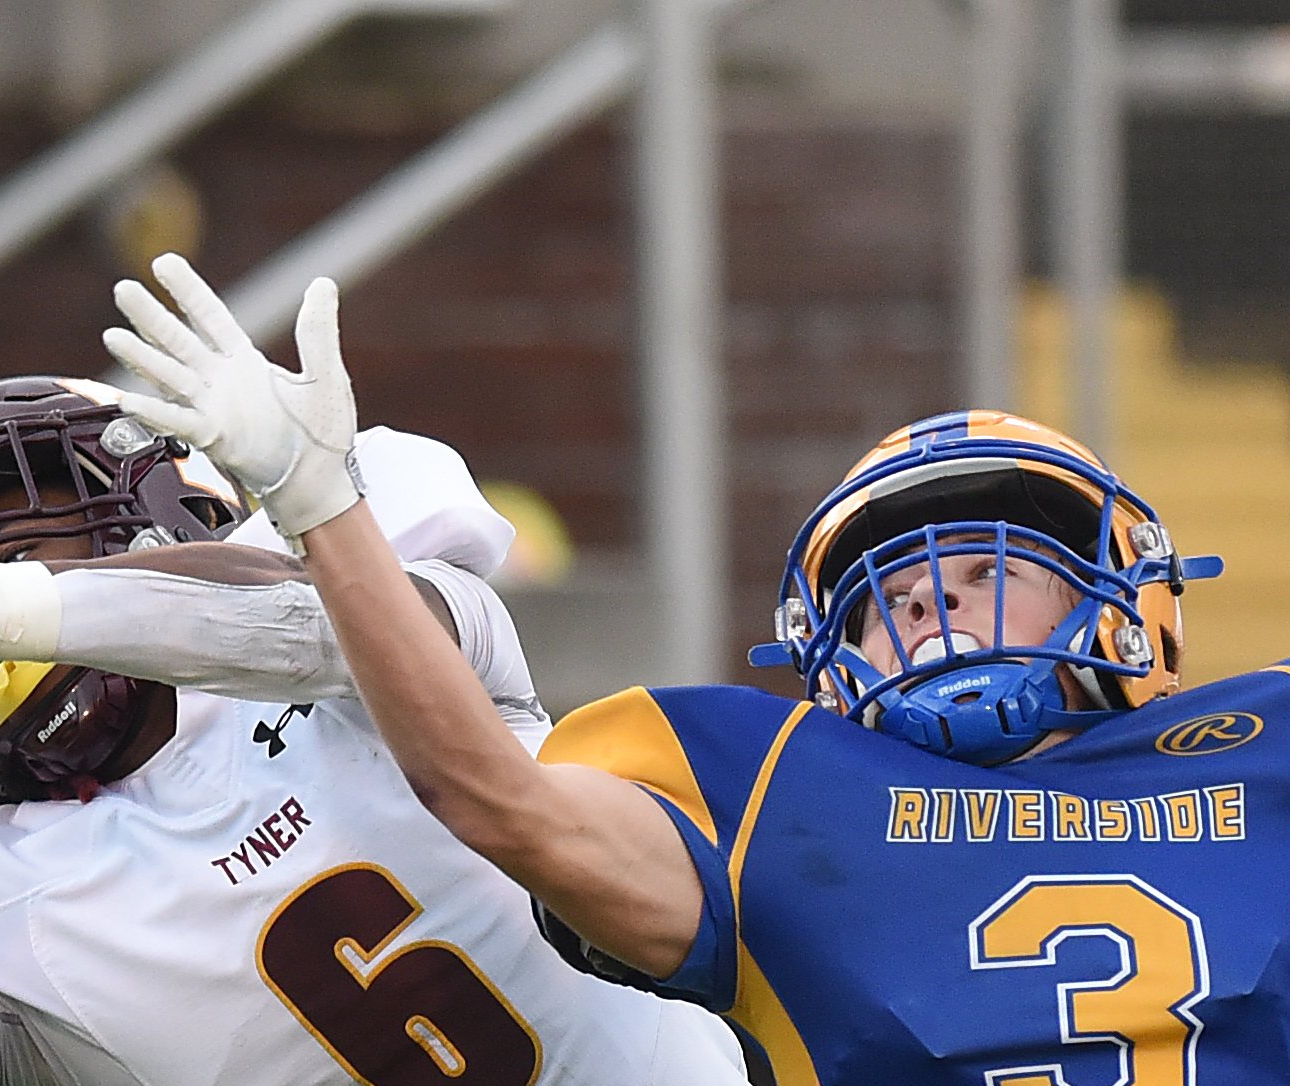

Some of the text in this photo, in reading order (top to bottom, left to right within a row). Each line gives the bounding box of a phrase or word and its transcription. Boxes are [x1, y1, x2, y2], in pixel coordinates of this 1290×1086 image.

[939, 676, 991, 697] Riddell
[38, 701, 76, 743] Riddell
[887, 783, 1246, 842] RIVERSIDE
[211, 796, 312, 886] TYNER
